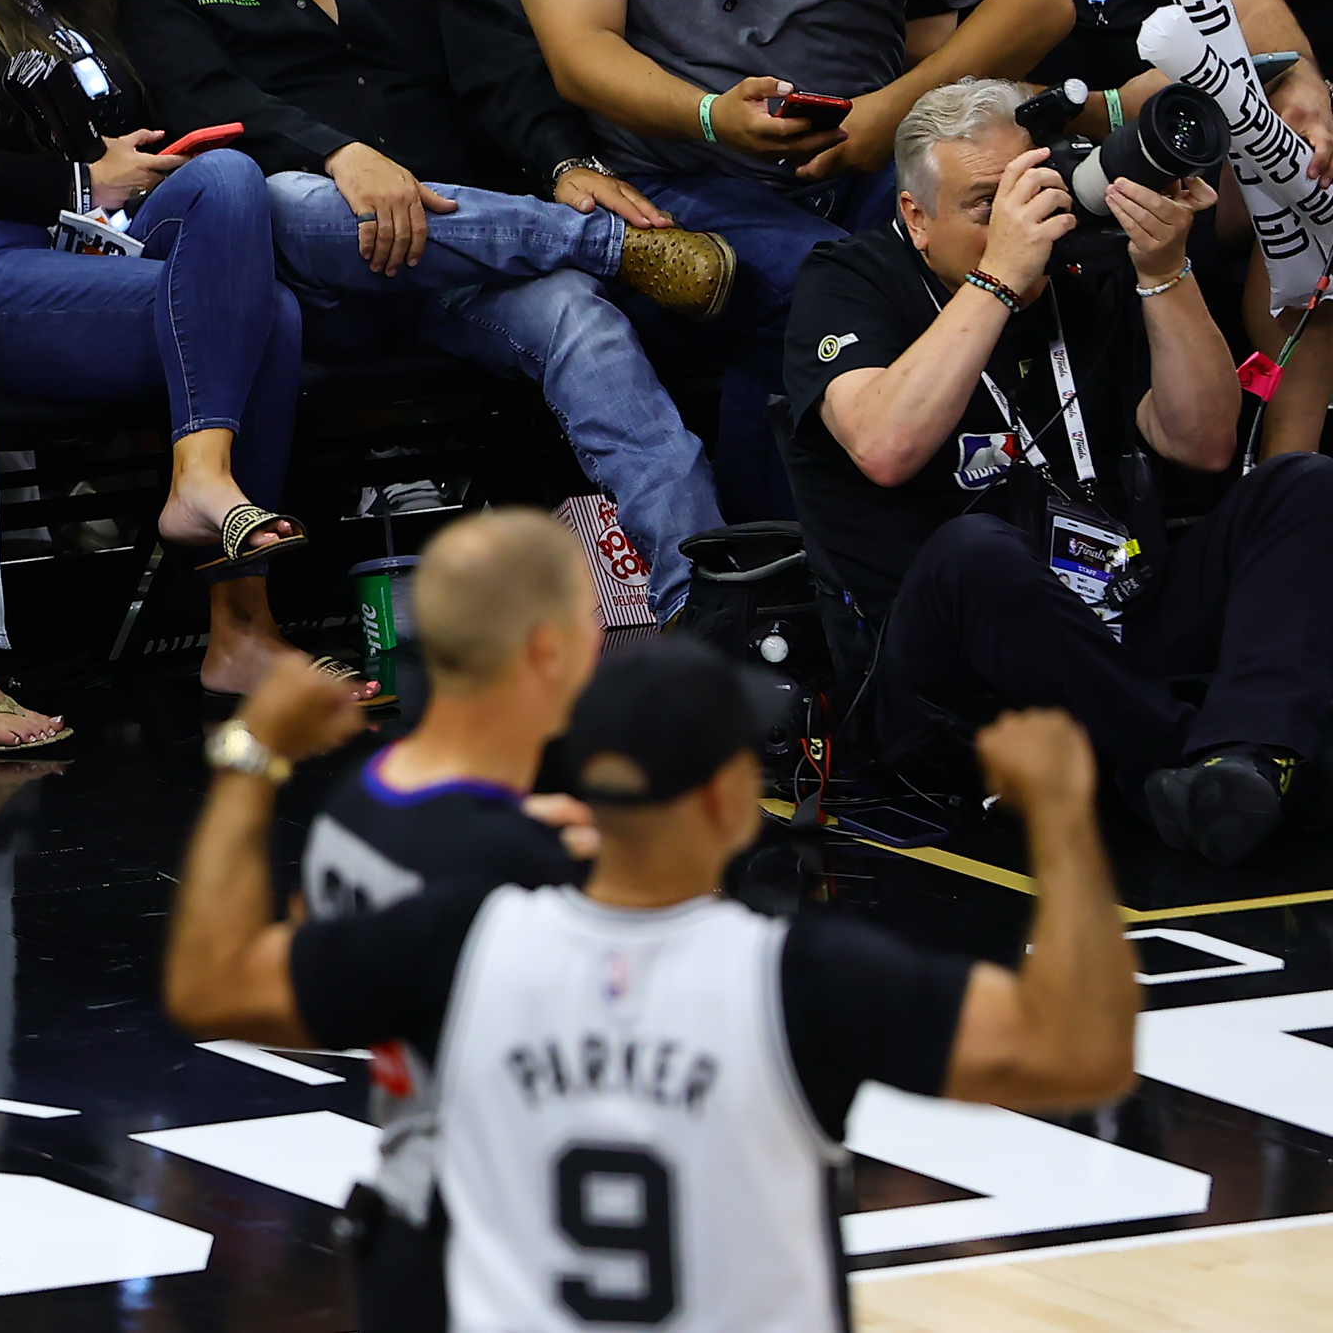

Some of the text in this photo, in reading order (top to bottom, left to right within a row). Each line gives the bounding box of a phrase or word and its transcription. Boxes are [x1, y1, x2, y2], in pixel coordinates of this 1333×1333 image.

[1179, 43, 1231, 99] GO
[1229, 79, 1309, 187] SPURS
[1252, 207, 1311, 261] GO
[1053, 351, 1069, 378] Finals
[1071, 432, 1086, 460] Finals
[965, 465, 1002, 482] NBA
[1073, 540, 1107, 562] Finals
[505, 1042, 719, 1118] PARKER
[551, 1141, 680, 1326] 9
